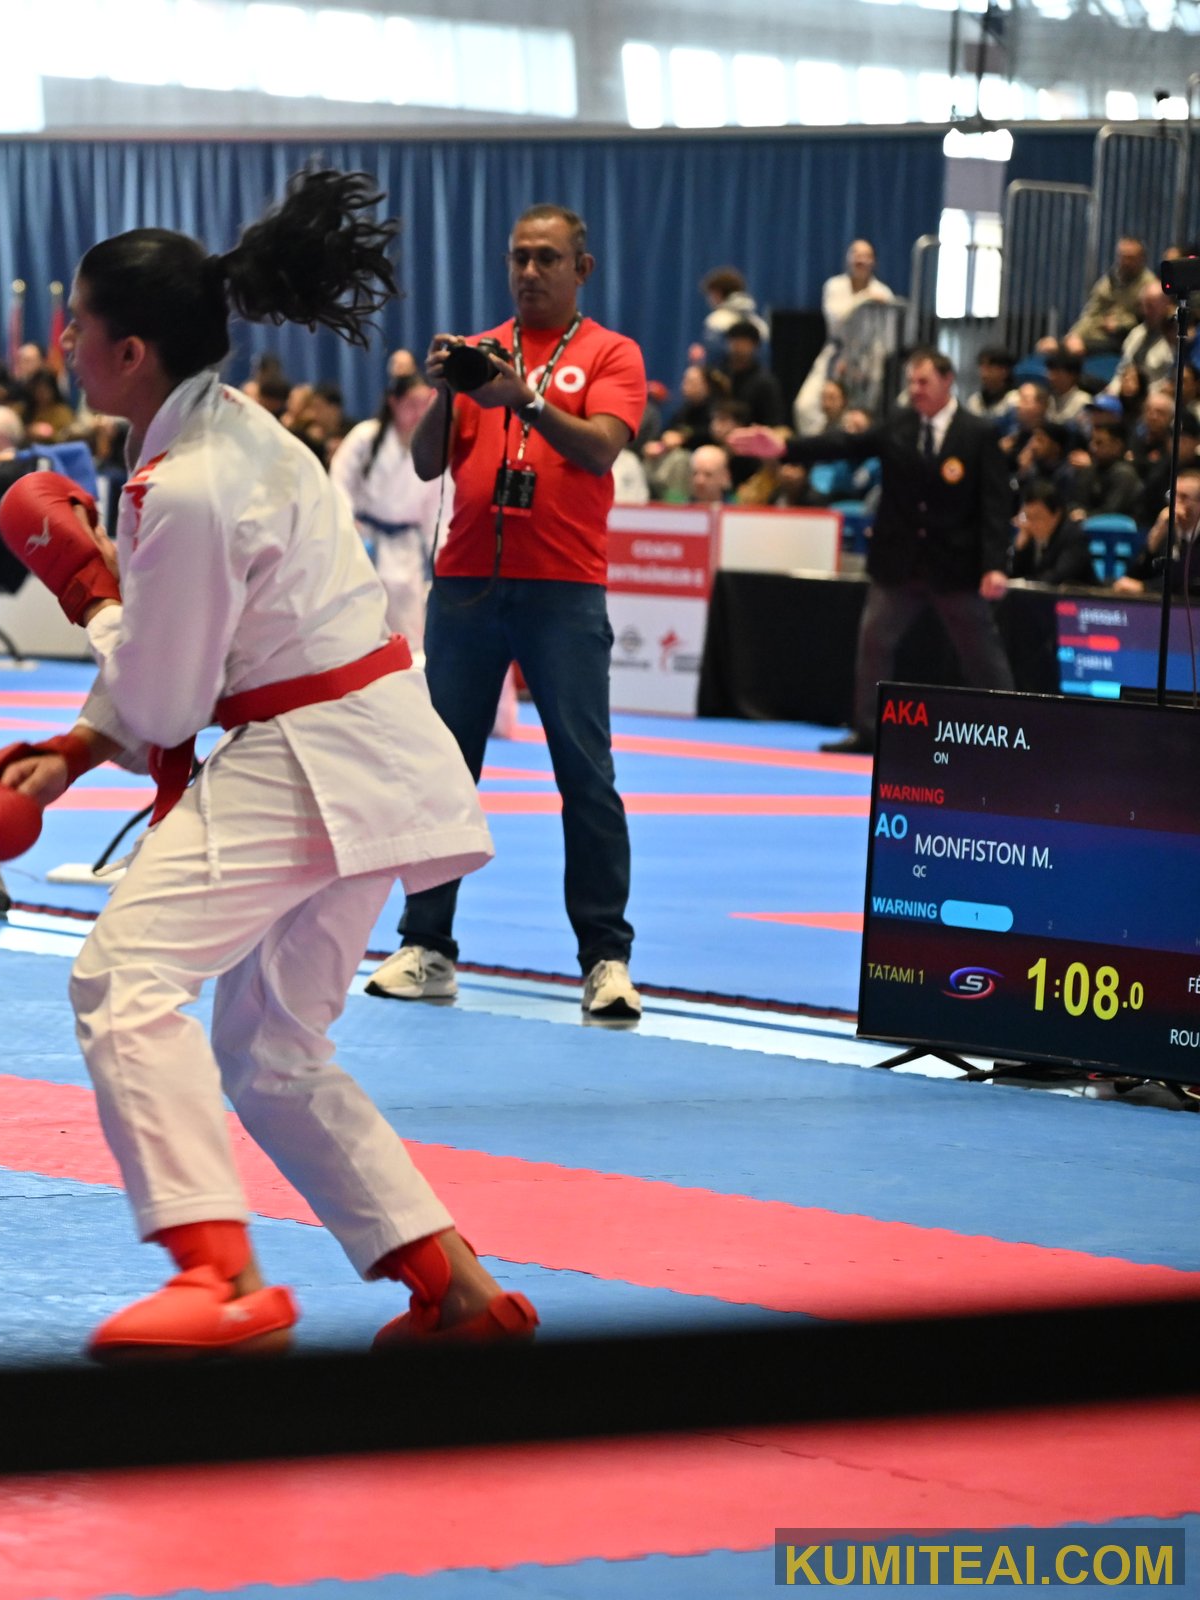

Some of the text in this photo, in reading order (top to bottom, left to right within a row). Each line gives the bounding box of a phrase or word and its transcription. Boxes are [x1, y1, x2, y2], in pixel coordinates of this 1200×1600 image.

[882, 699, 929, 727] AKA
[934, 720, 1031, 750] JAWKAR A.
[933, 751, 949, 765] ON
[880, 783, 945, 805] WARNING
[875, 812, 908, 840] AO
[915, 833, 1053, 869] MONFISTON M.
[912, 864, 927, 878] QC
[872, 896, 938, 919] WARNING
[868, 963, 924, 985] TATAMI 1
[1027, 957, 1144, 1020] 1:08.0
[1170, 1028, 1200, 1048] ROU
